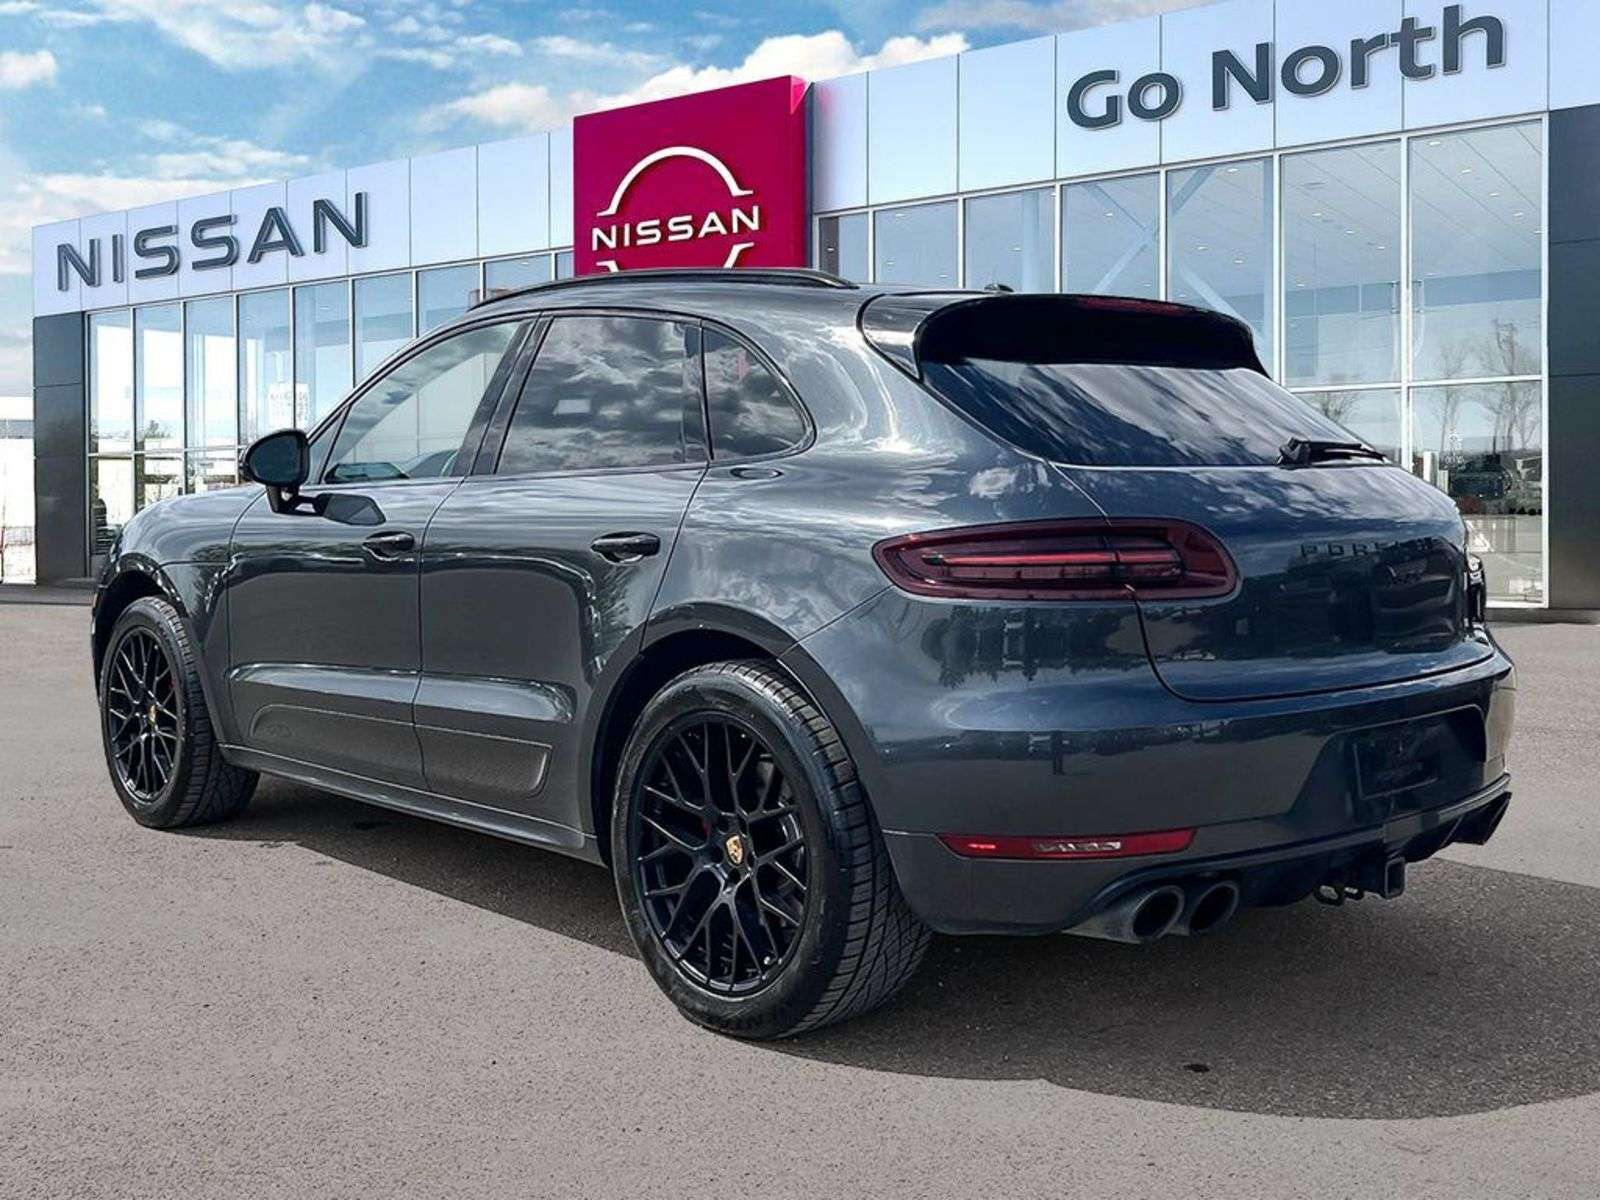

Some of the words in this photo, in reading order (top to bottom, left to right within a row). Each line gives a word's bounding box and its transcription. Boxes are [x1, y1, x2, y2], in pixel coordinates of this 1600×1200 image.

[1067, 69, 1183, 129] Go
[1212, 4, 1507, 111] North
[57, 192, 368, 291] NISSAN
[591, 205, 760, 251] NISSAN
